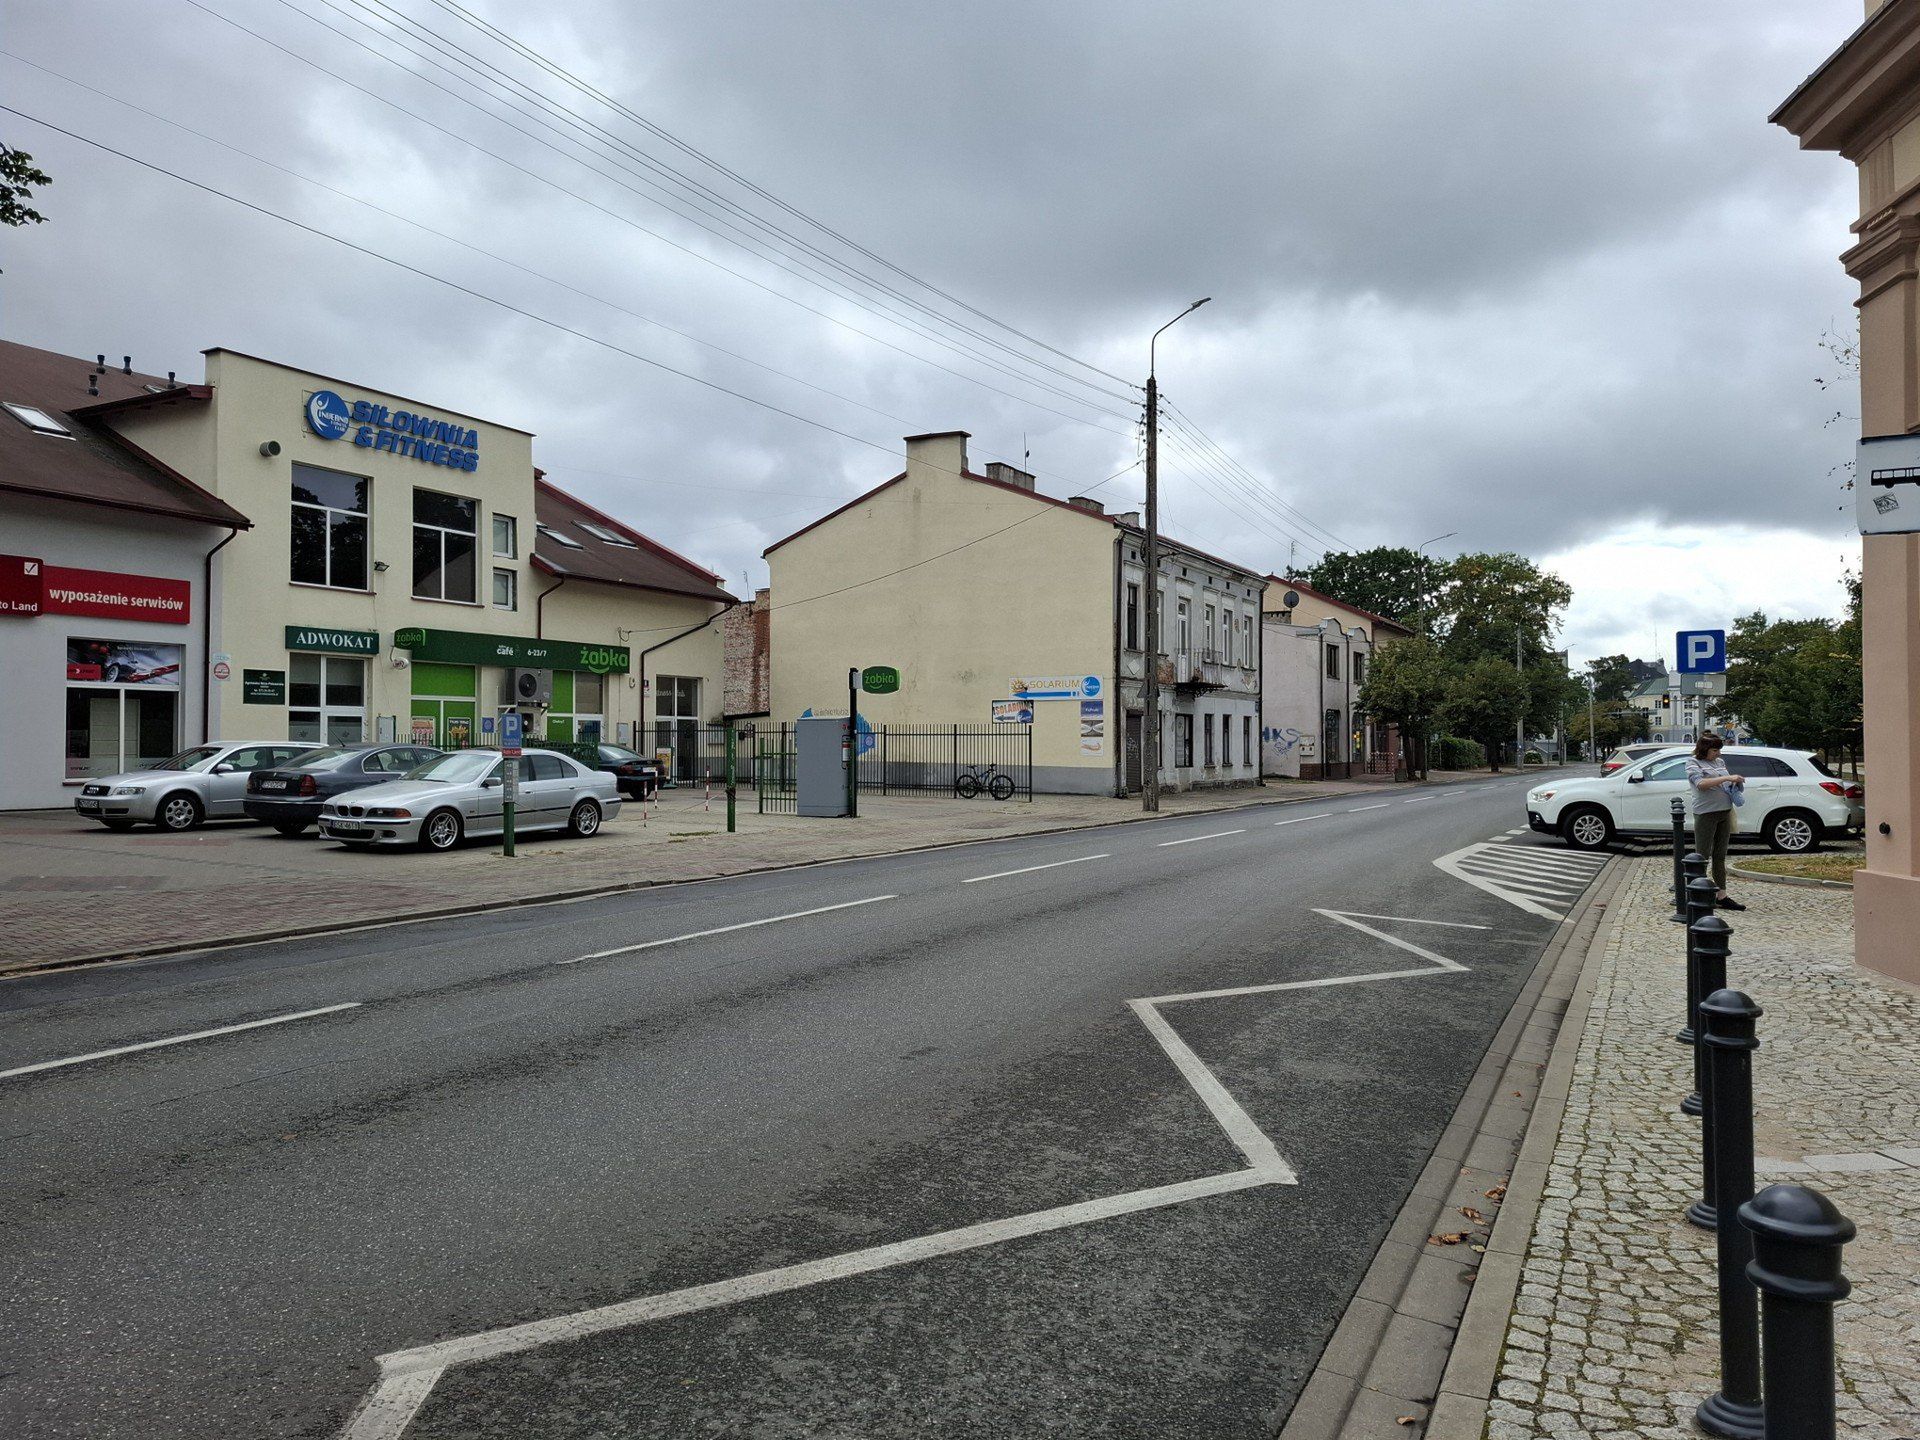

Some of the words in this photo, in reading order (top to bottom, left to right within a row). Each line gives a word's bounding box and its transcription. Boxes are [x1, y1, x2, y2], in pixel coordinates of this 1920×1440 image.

[352, 400, 478, 450] SIŁOWNIA
[355, 426, 373, 448] &
[375, 429, 479, 473] FITNESS
[11, 601, 38, 612] Land
[49, 587, 128, 606] wyposażenie
[131, 596, 184, 611] serwisów
[296, 632, 374, 649] ADWOKAT
[496, 646, 514, 656] café
[580, 646, 628, 666] żabka
[1687, 635, 1715, 668] P
[865, 673, 895, 683] żabka
[1028, 680, 1080, 689] SOLARIUM
[506, 716, 518, 736] P
